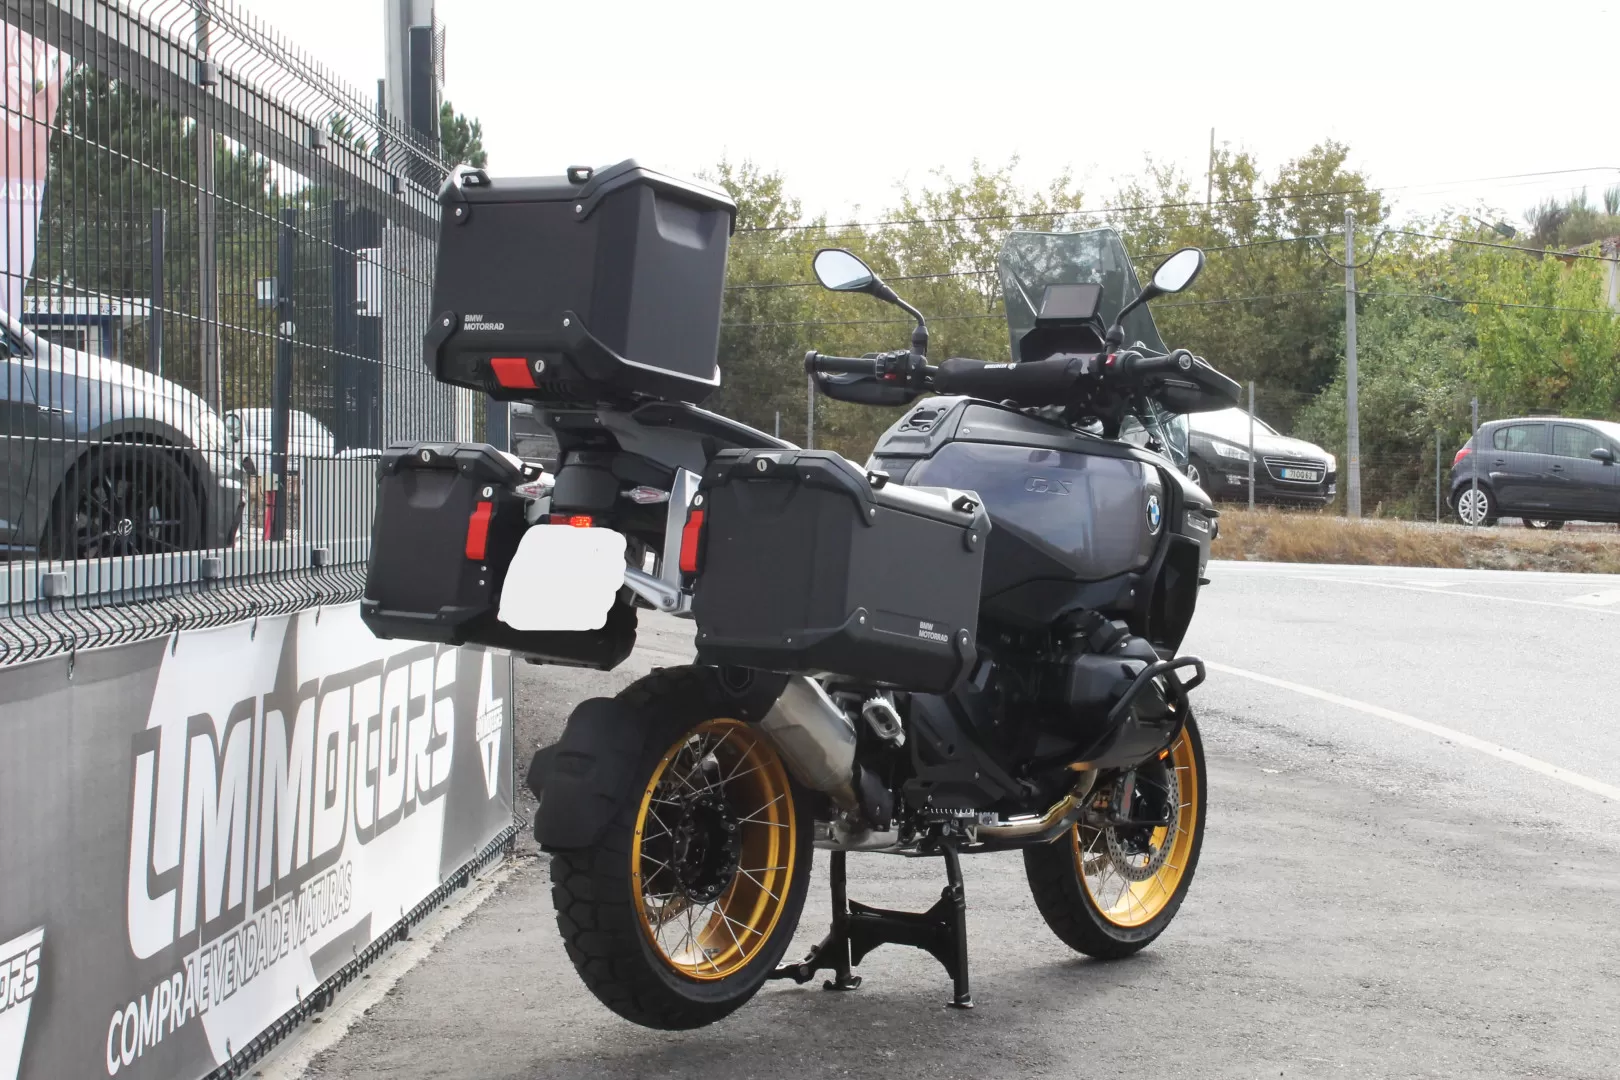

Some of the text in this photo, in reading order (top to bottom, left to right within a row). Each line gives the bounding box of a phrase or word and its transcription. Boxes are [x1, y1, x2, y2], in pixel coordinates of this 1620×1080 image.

[464, 314, 483, 322] BMW
[463, 322, 505, 330] MOTORRAD
[919, 621, 934, 631] BMW
[918, 629, 949, 642] MOTORRAD
[106, 961, 196, 1076] COMPRA
[211, 911, 268, 1006] VENDA
[268, 896, 291, 966] DE
[291, 860, 353, 950] VIATURAS
